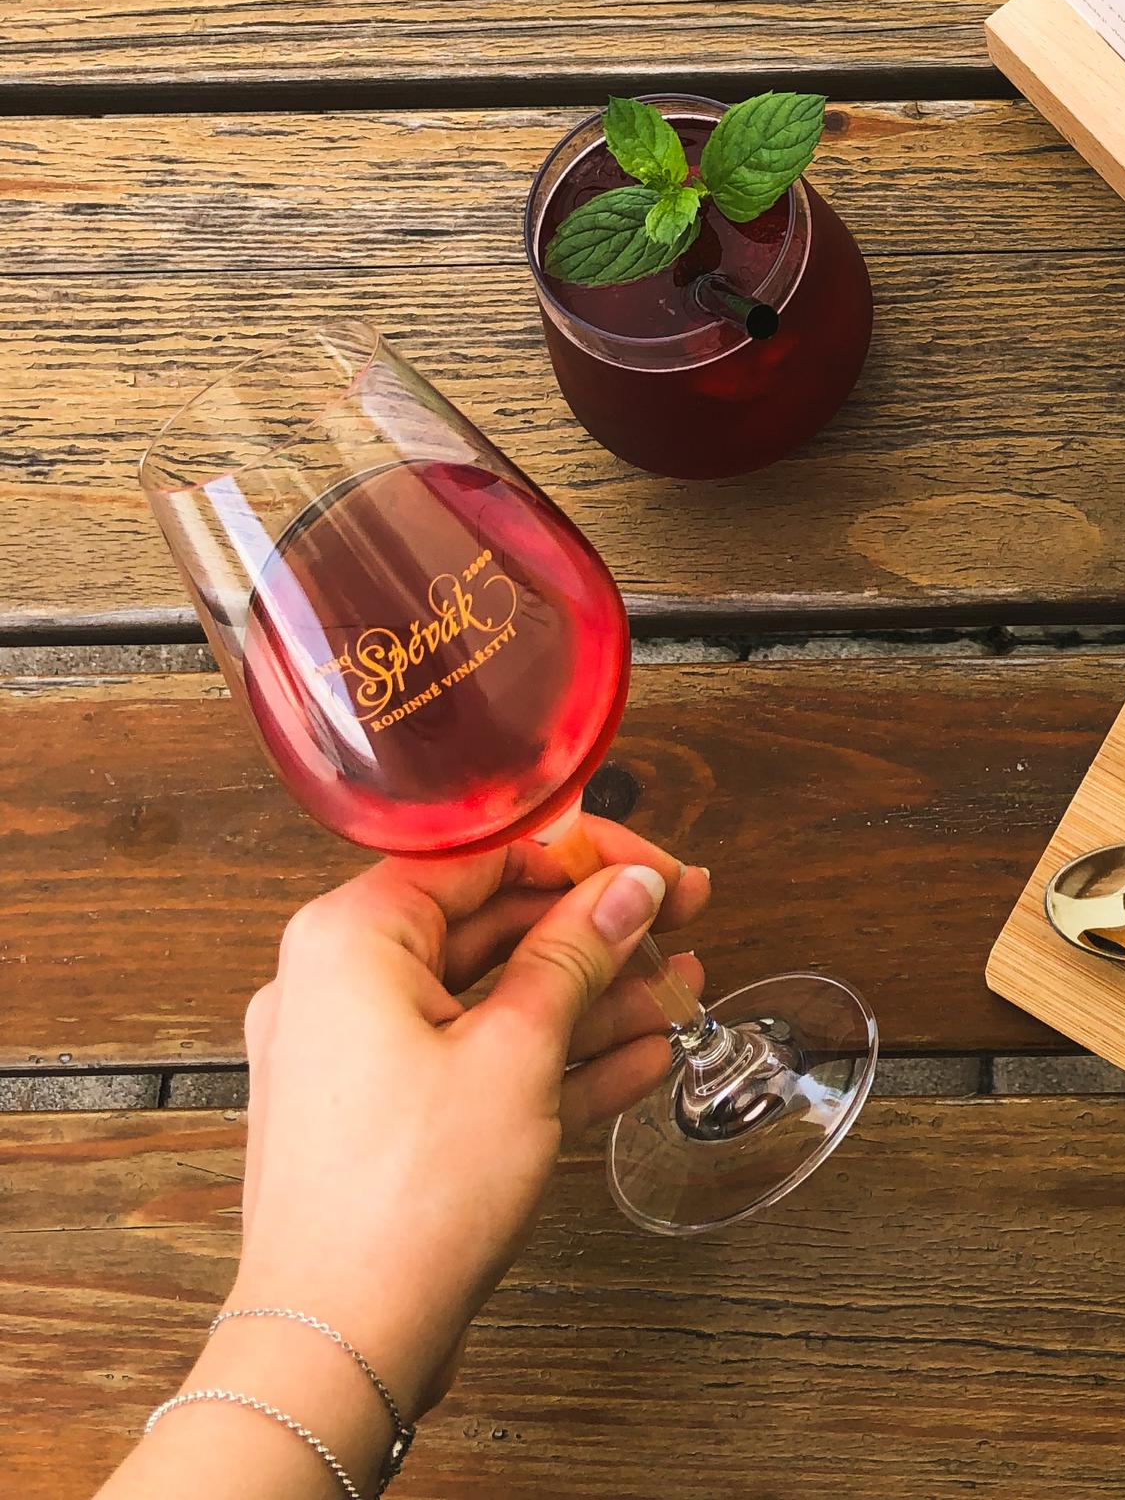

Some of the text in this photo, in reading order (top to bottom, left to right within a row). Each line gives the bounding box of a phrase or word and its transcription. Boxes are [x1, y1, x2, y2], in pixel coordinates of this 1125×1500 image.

[462, 549, 493, 582] 2000
[352, 574, 514, 717] Spěvák
[369, 622, 518, 733] RODINNÉ VINAŘSTVÍ
